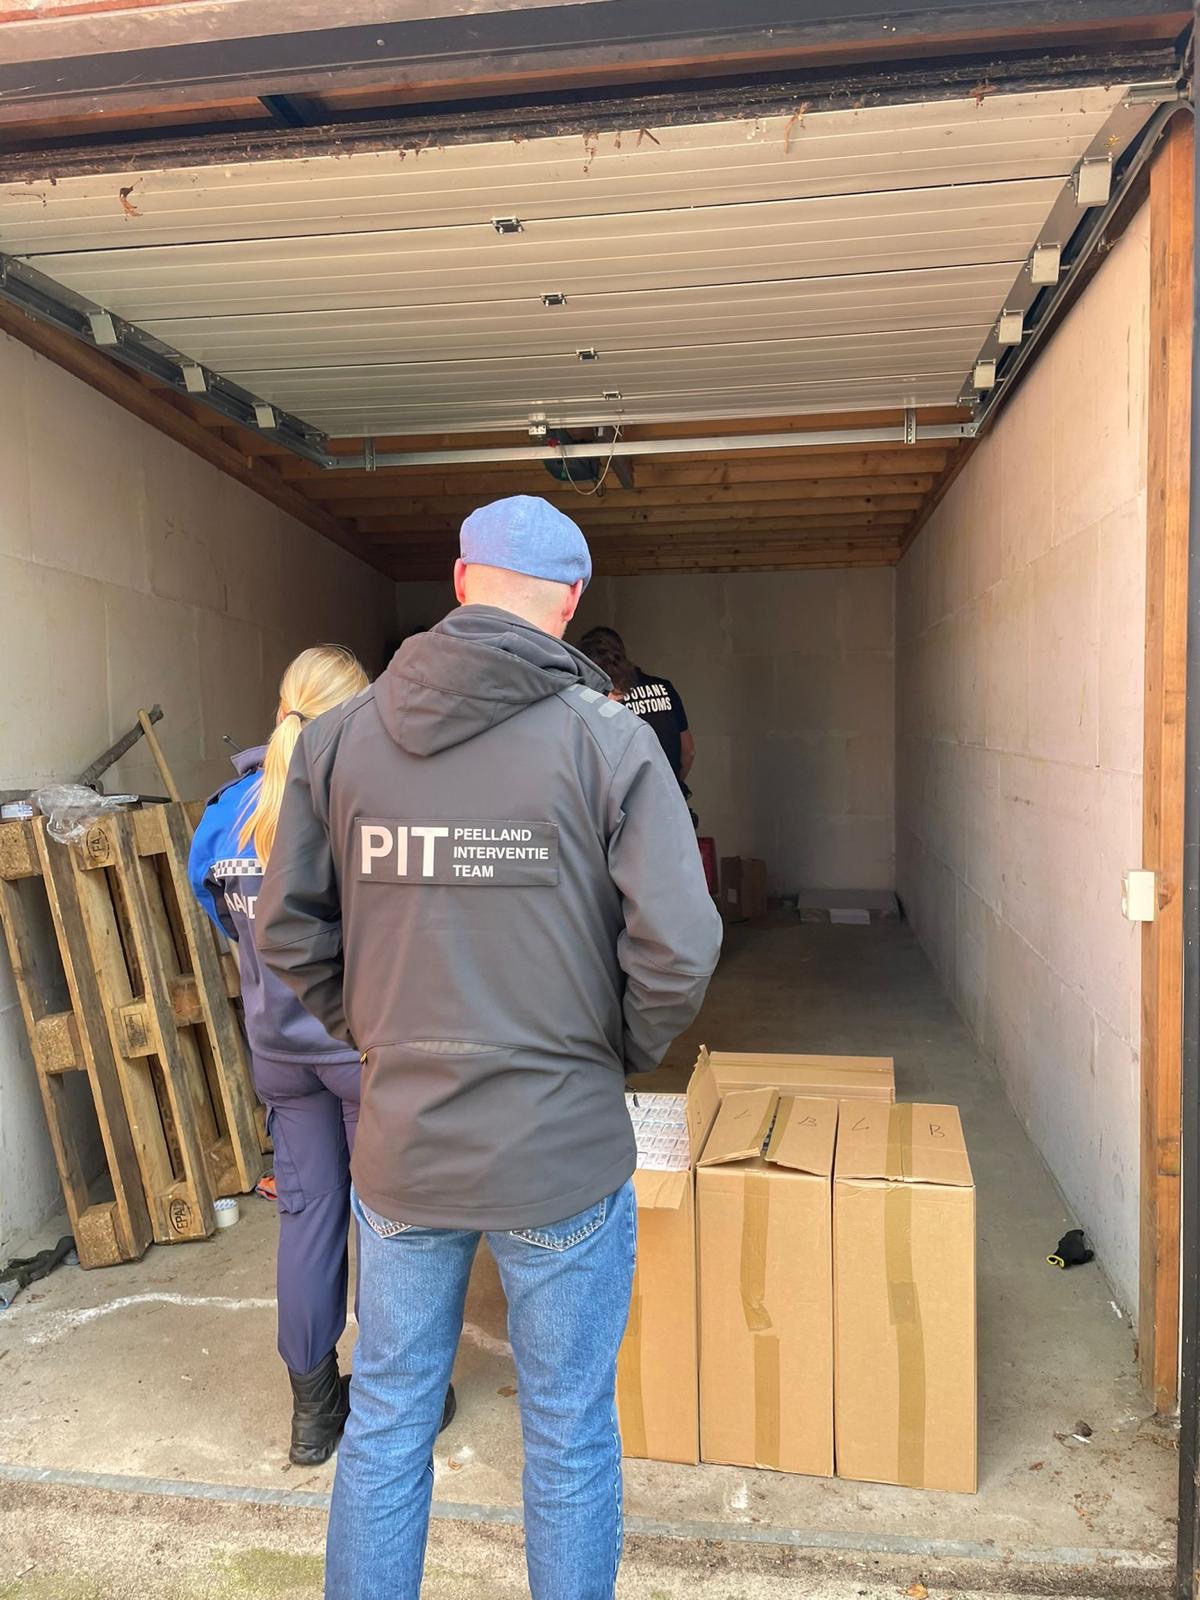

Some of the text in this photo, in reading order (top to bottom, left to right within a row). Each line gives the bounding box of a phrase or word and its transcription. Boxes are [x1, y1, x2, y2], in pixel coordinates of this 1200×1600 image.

[625, 697, 672, 715] CUSTOMS
[454, 828, 532, 841] PEELLAND
[361, 825, 449, 877] PIT
[453, 847, 549, 860] INTERVENTIE
[453, 865, 494, 878] TEAM
